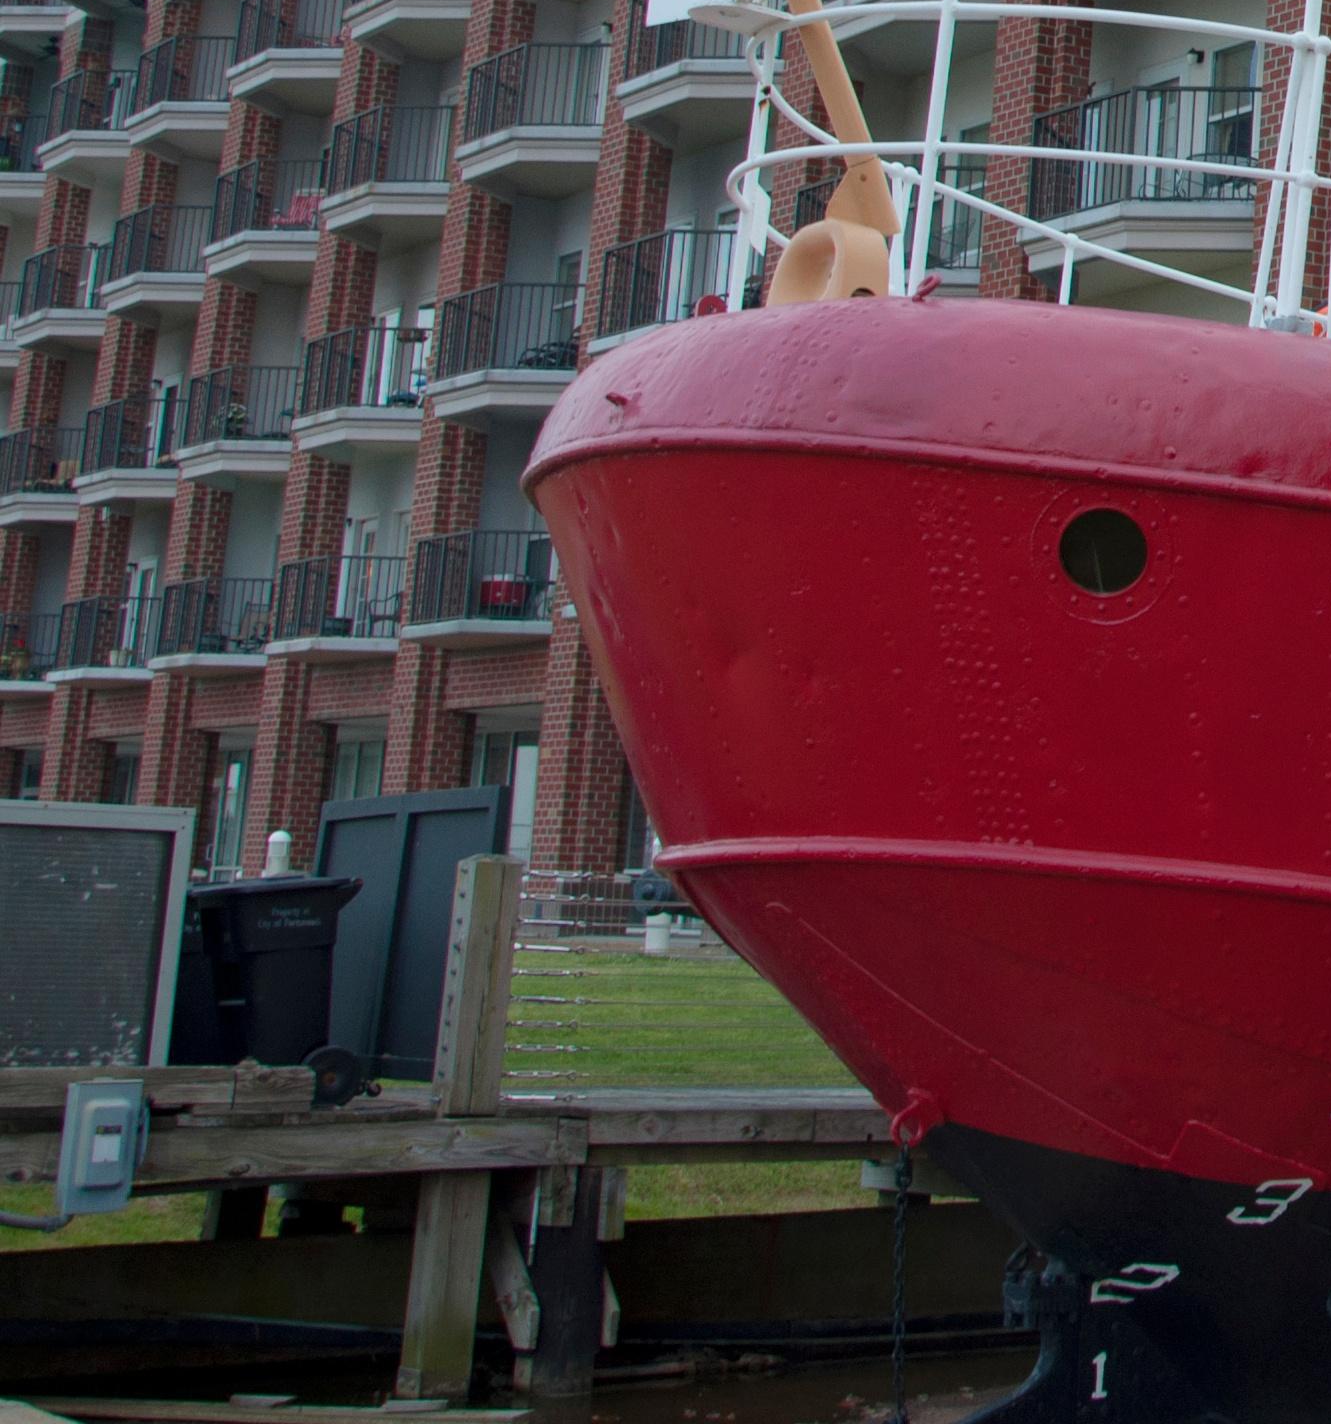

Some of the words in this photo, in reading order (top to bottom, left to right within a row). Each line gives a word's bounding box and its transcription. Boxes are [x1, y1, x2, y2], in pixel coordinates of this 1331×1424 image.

[1226, 1178, 1314, 1225] 3
[1090, 1263, 1180, 1304] 2
[1091, 1350, 1108, 1400] 1
